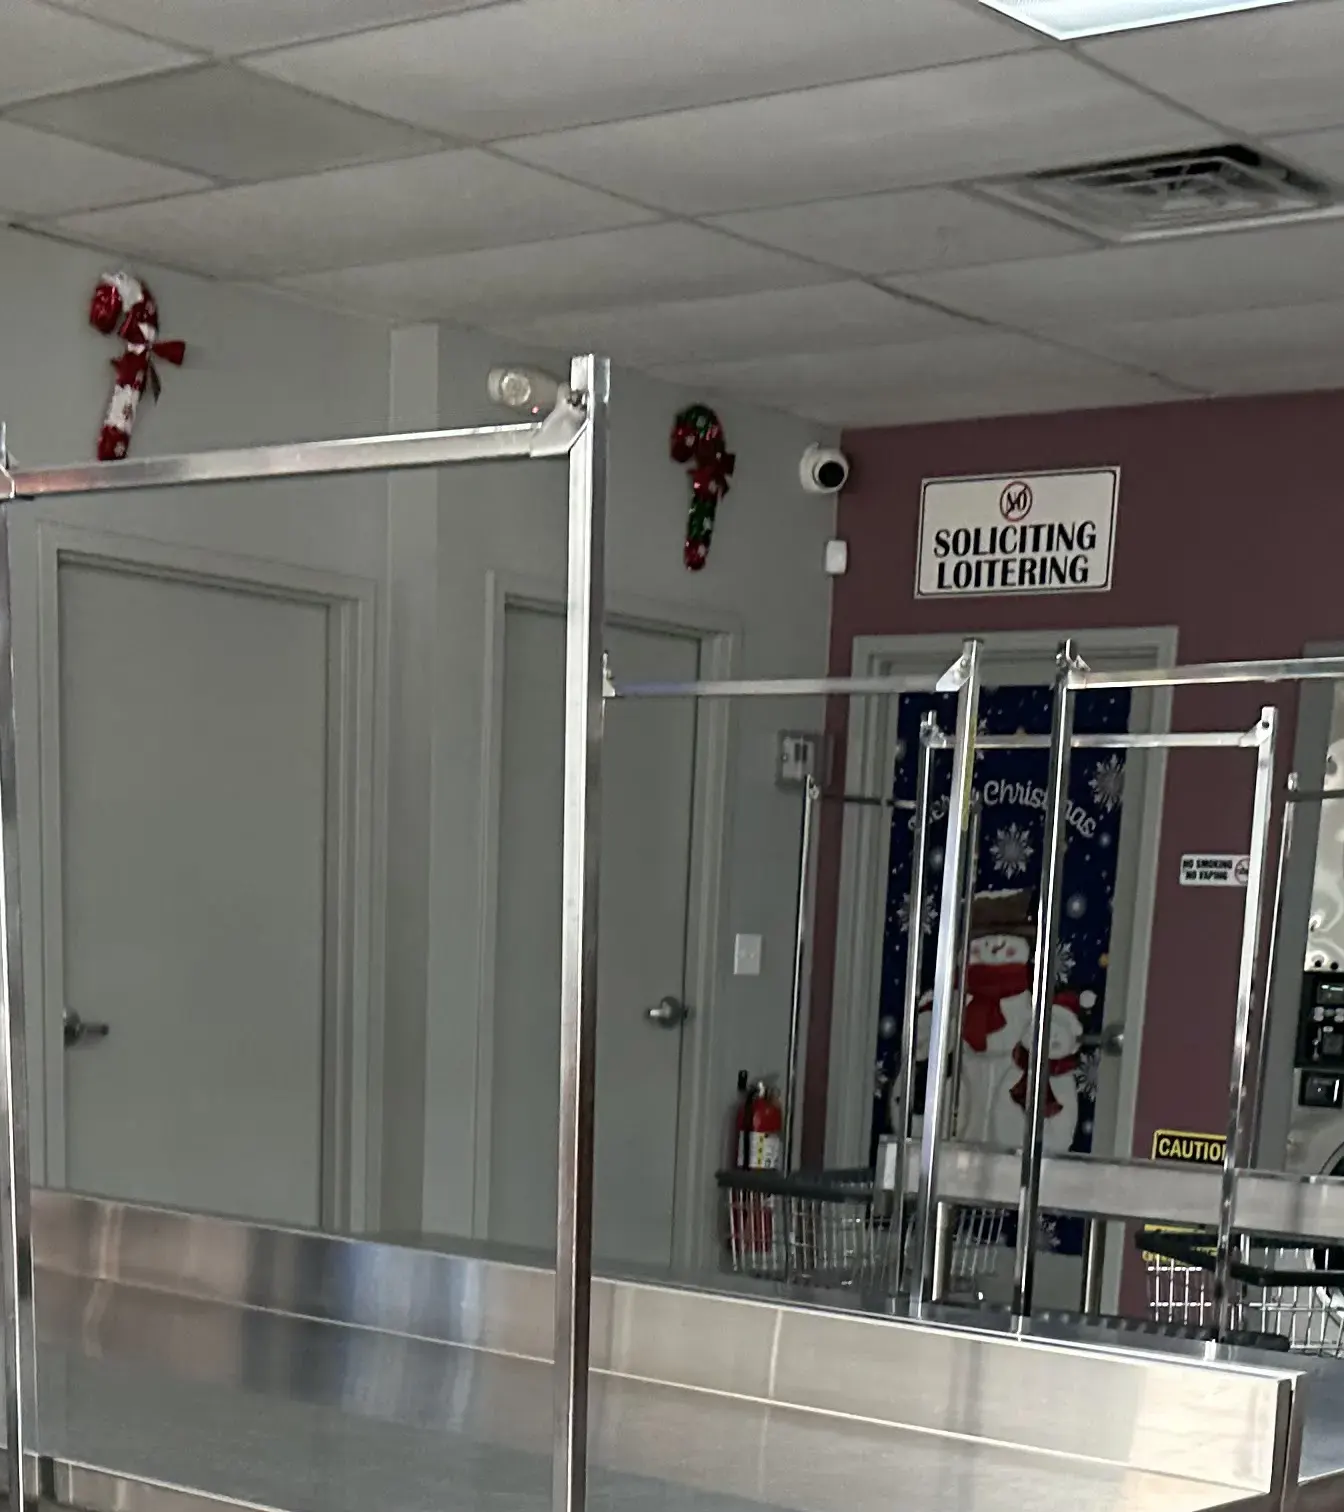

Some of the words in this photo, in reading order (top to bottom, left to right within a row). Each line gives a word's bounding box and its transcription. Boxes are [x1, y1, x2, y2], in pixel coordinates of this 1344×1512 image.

[933, 520, 1097, 559] SOLICITING
[937, 554, 1089, 590] LOITERING
[1183, 859, 1194, 869] NO
[1196, 859, 1233, 869] SMOKING
[1158, 1137, 1227, 1162] CAUTIO
